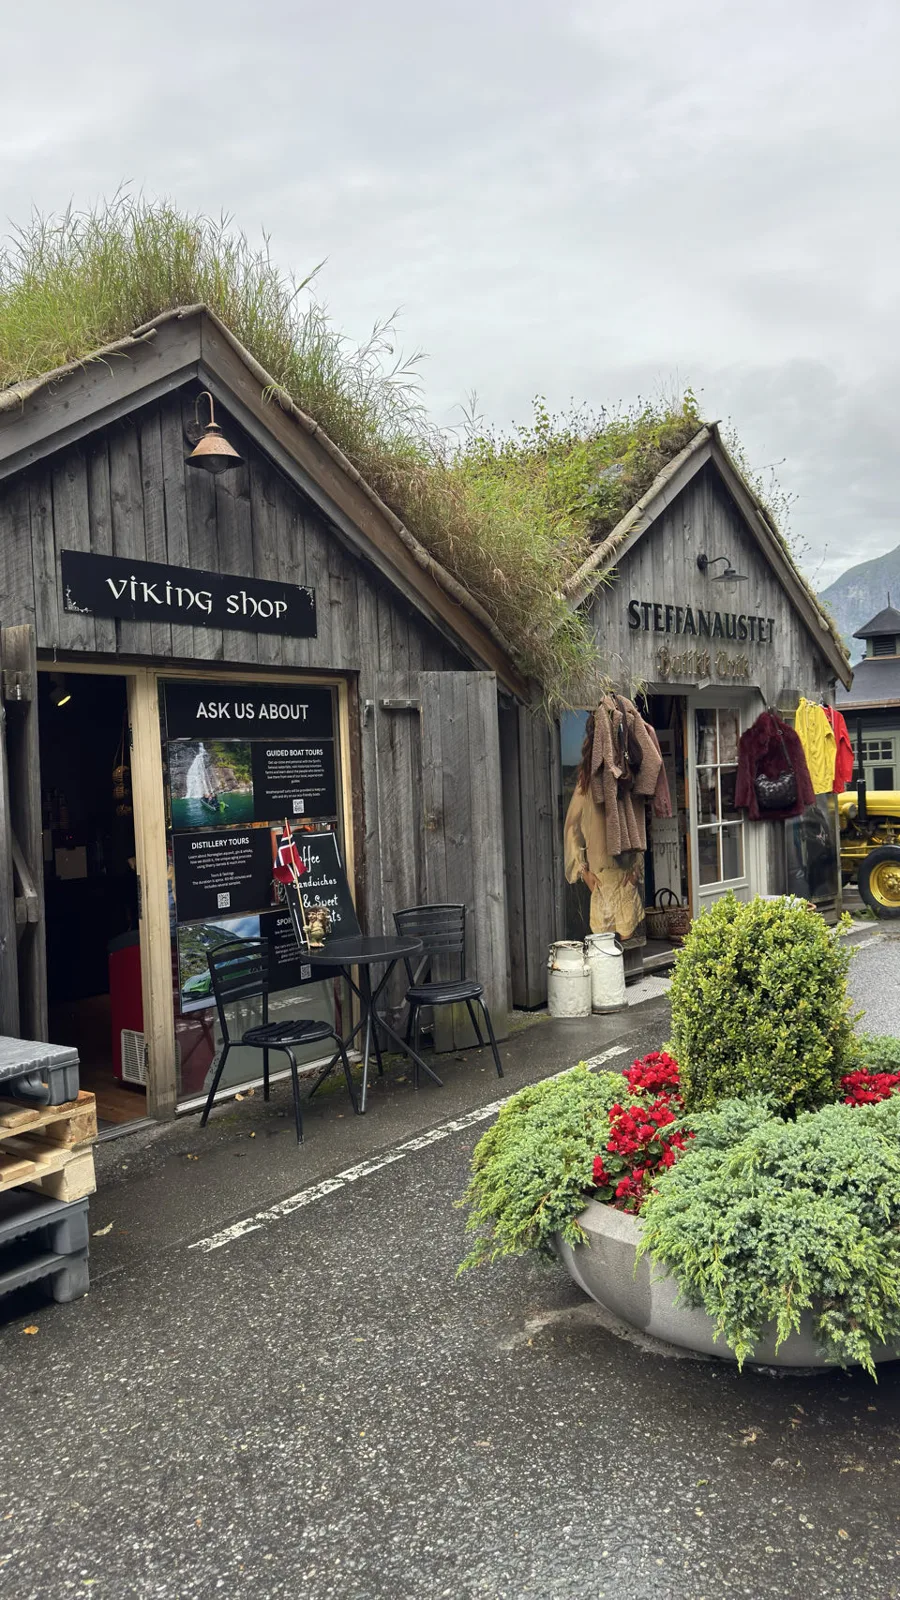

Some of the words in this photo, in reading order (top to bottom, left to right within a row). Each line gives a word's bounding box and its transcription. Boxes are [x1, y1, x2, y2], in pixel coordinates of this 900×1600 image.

[196, 702, 231, 719] ASK
[235, 703, 255, 719] US
[258, 704, 309, 720] ABOUT
[191, 840, 227, 850] DISTILLERY
[229, 838, 249, 846] TOURS
[299, 845, 320, 873] ffee
[293, 874, 337, 889] Sandwiches
[303, 894, 311, 908] &
[312, 894, 338, 907] Sweet
